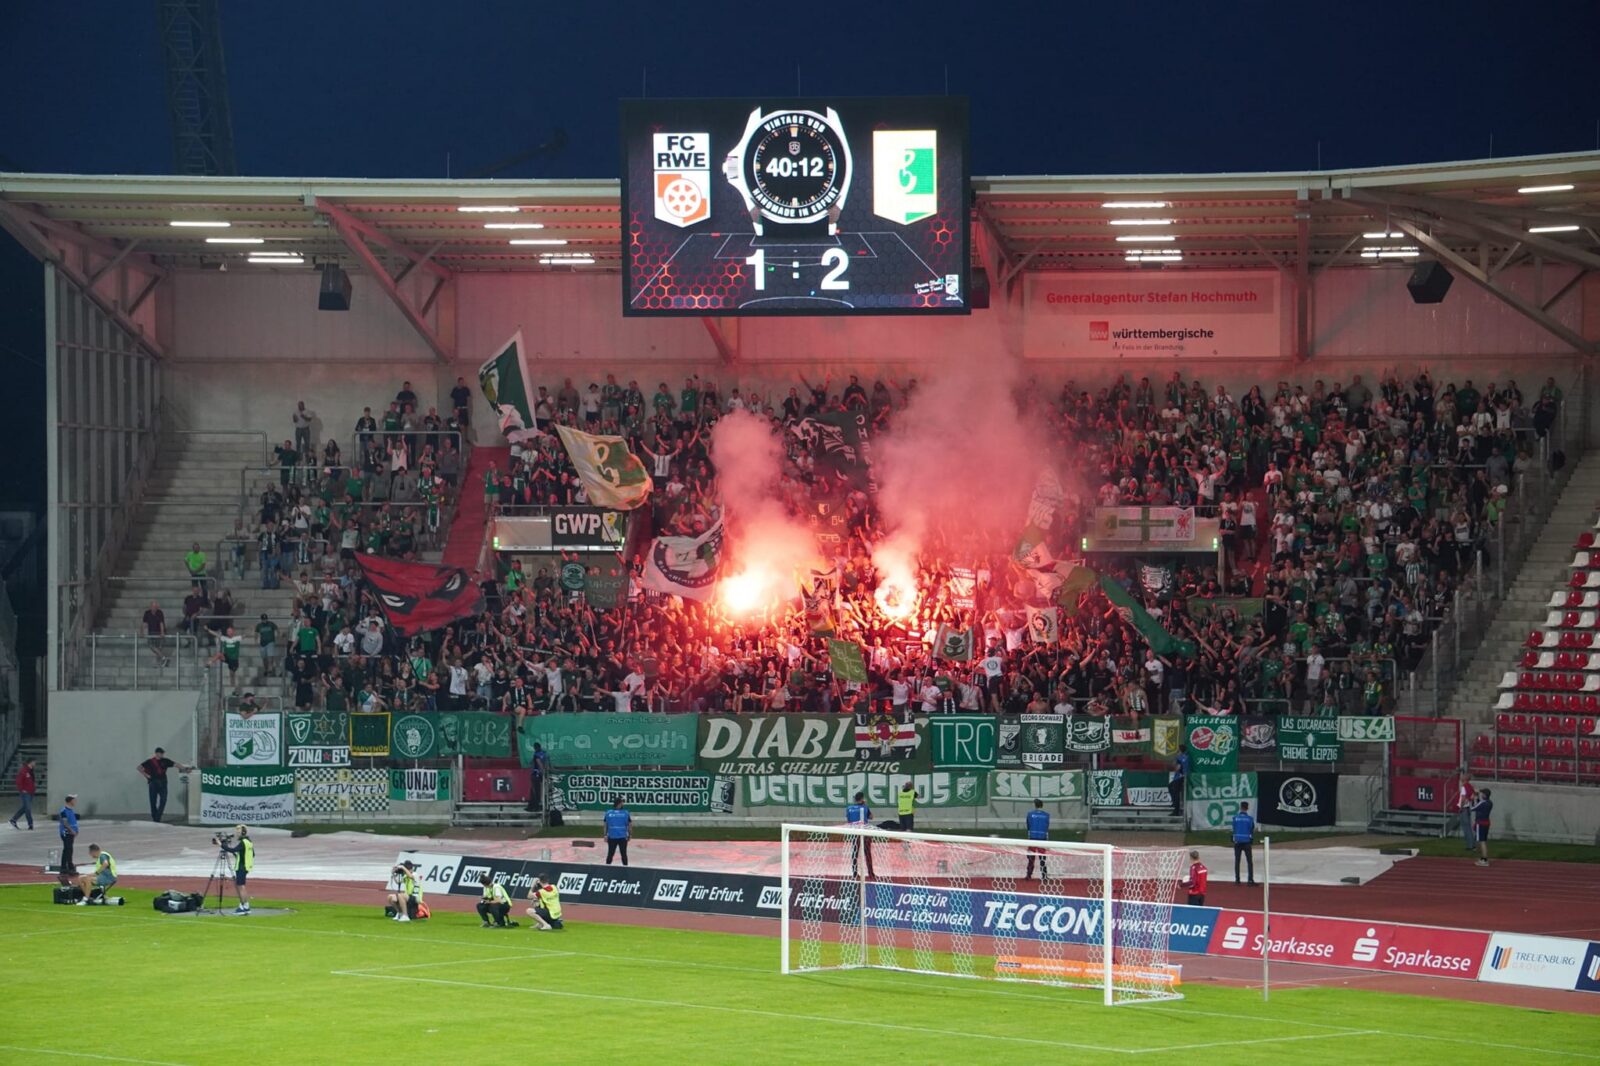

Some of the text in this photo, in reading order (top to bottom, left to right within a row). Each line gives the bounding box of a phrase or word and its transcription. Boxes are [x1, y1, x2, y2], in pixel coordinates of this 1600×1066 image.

[764, 115, 805, 132] VINTAGE
[667, 135, 696, 151] FC
[657, 152, 706, 168] RWE
[765, 157, 825, 178] 40:12
[752, 185, 839, 218] HANDMADE IN ERFURT
[745, 249, 765, 290] 1
[820, 248, 850, 291] 2
[1046, 289, 1258, 305] Generalagentur Stefan Hochmuth
[1112, 328, 1214, 341] württembergische
[554, 513, 601, 535] GWP
[229, 719, 276, 729] SPORTSFREUNDE
[1022, 714, 1038, 722] GEORG
[1281, 717, 1339, 731] LAS CUCARACHAS
[462, 720, 510, 747] 1964
[700, 716, 930, 759] DIABLS
[932, 722, 995, 763] TRC
[288, 749, 349, 766] ZONA 64
[860, 748, 913, 760] 9 7
[1023, 754, 1063, 762] BRIGADE
[1282, 747, 1339, 761] CHEMIE LEIPZIG
[718, 760, 900, 775] ULTRAS CHEMIE LEIPZIG
[201, 772, 294, 788] BSG CHEMIE LEIPZIG
[393, 770, 437, 791] GRUNAU
[496, 779, 504, 791] F
[569, 776, 709, 790] GEGEN REPRESSIONEN
[569, 791, 595, 804] UND
[600, 788, 699, 805] ÜBERWACHUNG
[1418, 788, 1425, 800] H
[425, 865, 453, 883] AG
[492, 871, 511, 887] Für
[510, 872, 538, 888] Erfu
[560, 876, 641, 895] SWE Für Erfurt.
[659, 883, 744, 903] SWE Für Erfurt.
[793, 893, 815, 908] Für
[814, 895, 852, 911] Erfurt.
[896, 893, 948, 908] JOBS FÜR
[863, 907, 973, 926] DIGITALE LÖSUNGEN
[983, 900, 1101, 936] TECCON
[1111, 917, 1209, 938] WWW.TECCON.DE
[1251, 933, 1335, 958] Sparkasse
[1383, 946, 1472, 972] Sparkasse
[1515, 951, 1576, 966] TREUENBURG
